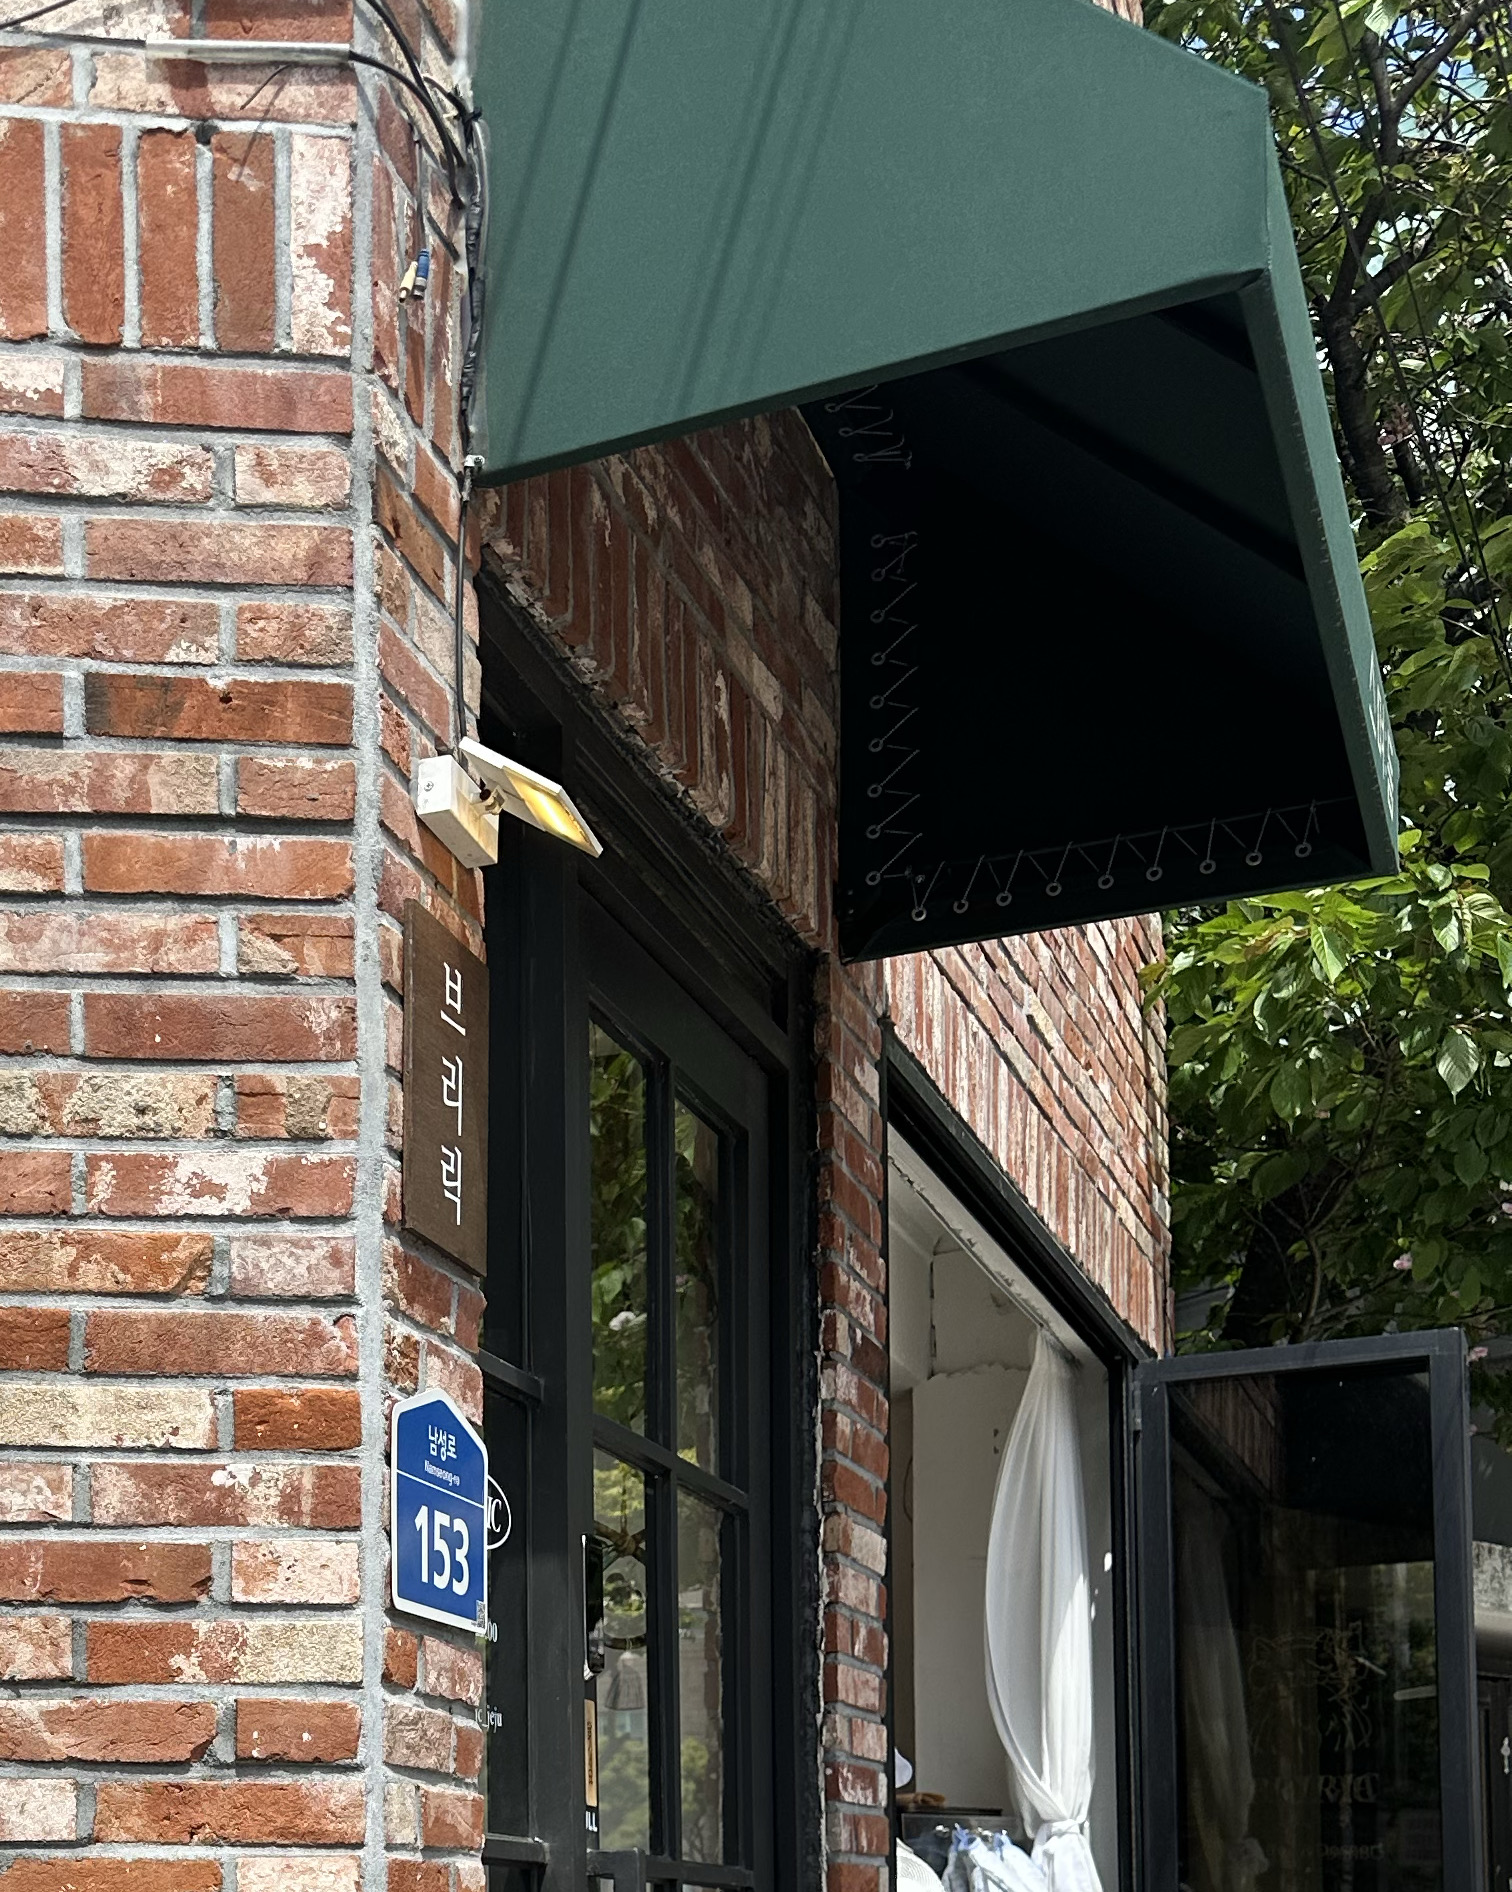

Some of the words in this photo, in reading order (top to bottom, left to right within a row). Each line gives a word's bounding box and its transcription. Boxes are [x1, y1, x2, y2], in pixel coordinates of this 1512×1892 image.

[440, 961, 466, 1226] 브리릭
[428, 1424, 458, 1462] 남성로
[414, 1504, 470, 1596] 153
